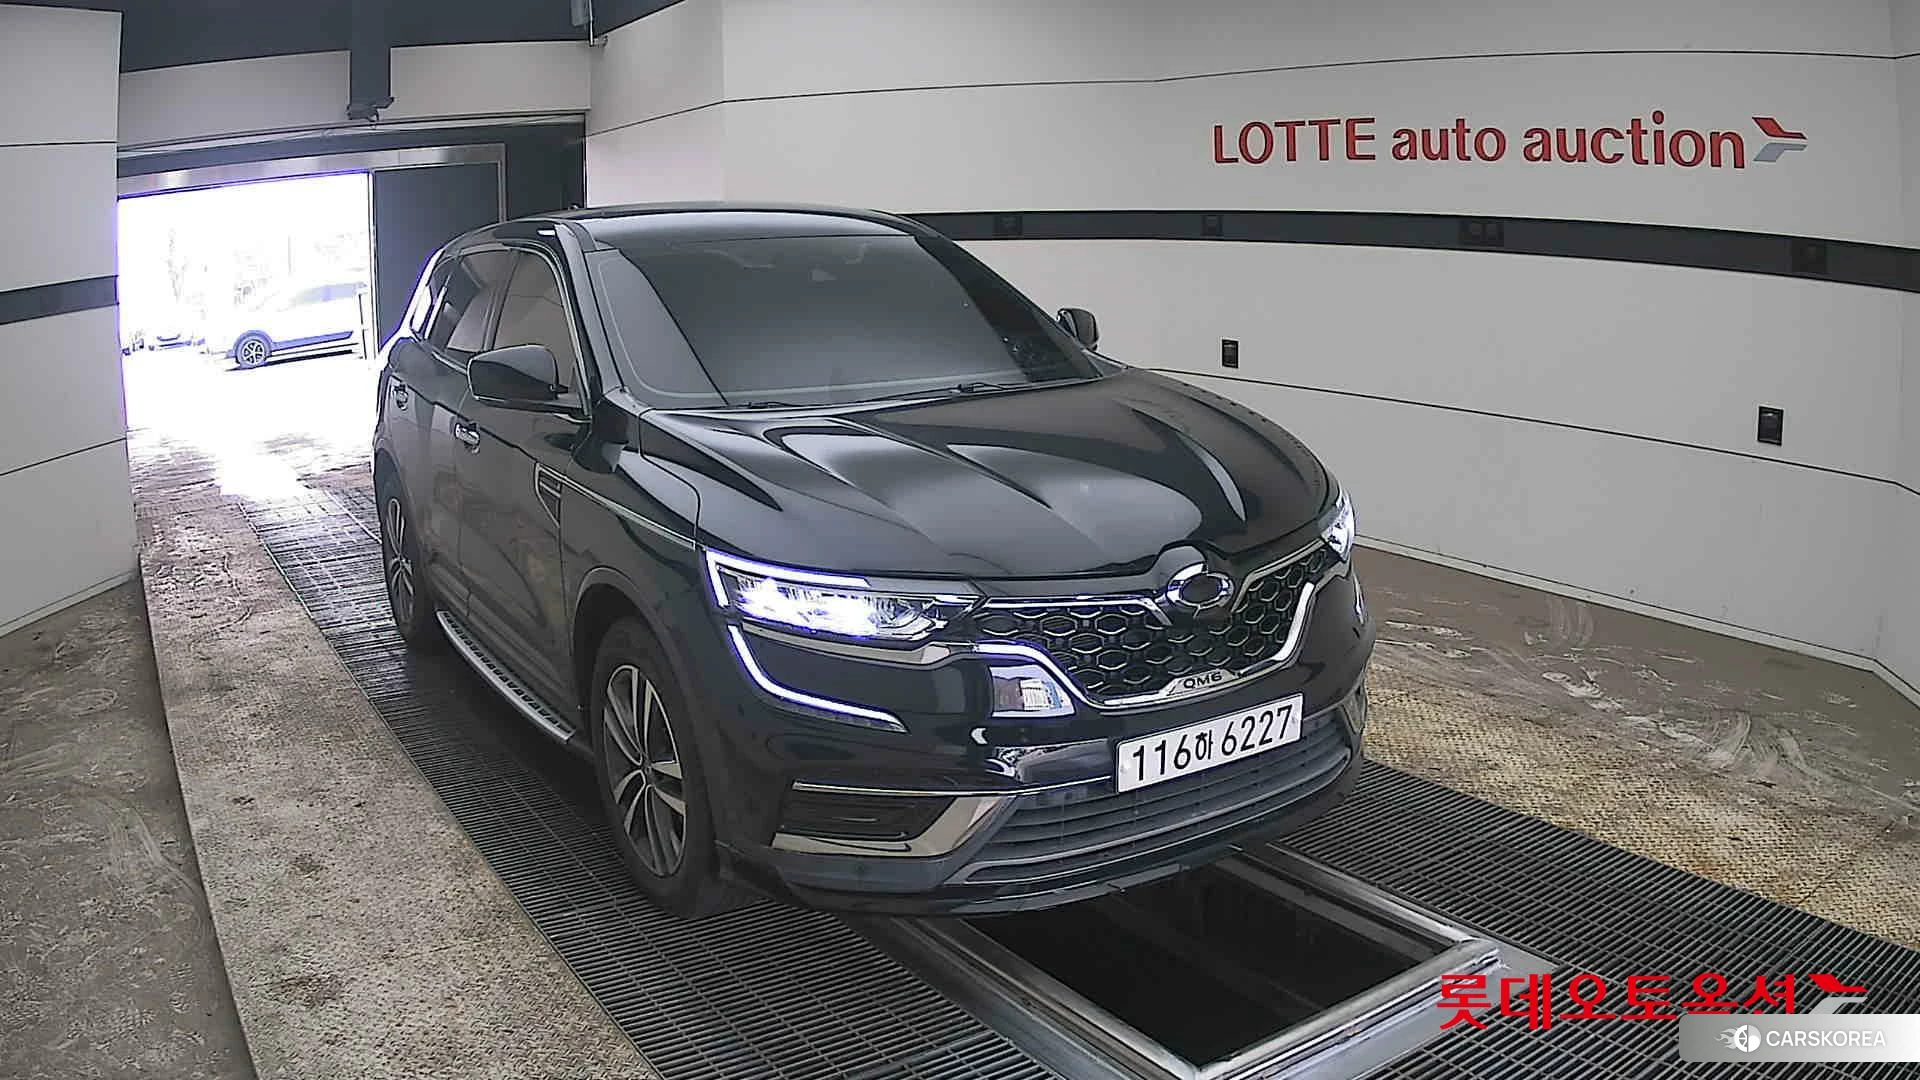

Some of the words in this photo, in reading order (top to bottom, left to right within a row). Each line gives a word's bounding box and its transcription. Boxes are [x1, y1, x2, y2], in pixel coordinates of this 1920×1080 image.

[1213, 117, 1377, 164] LOTTE
[1391, 118, 1507, 162] auto
[1522, 110, 1746, 169] auction
[1183, 671, 1222, 689] QM6
[1132, 729, 1213, 781] 116하
[1221, 704, 1293, 756] 6227
